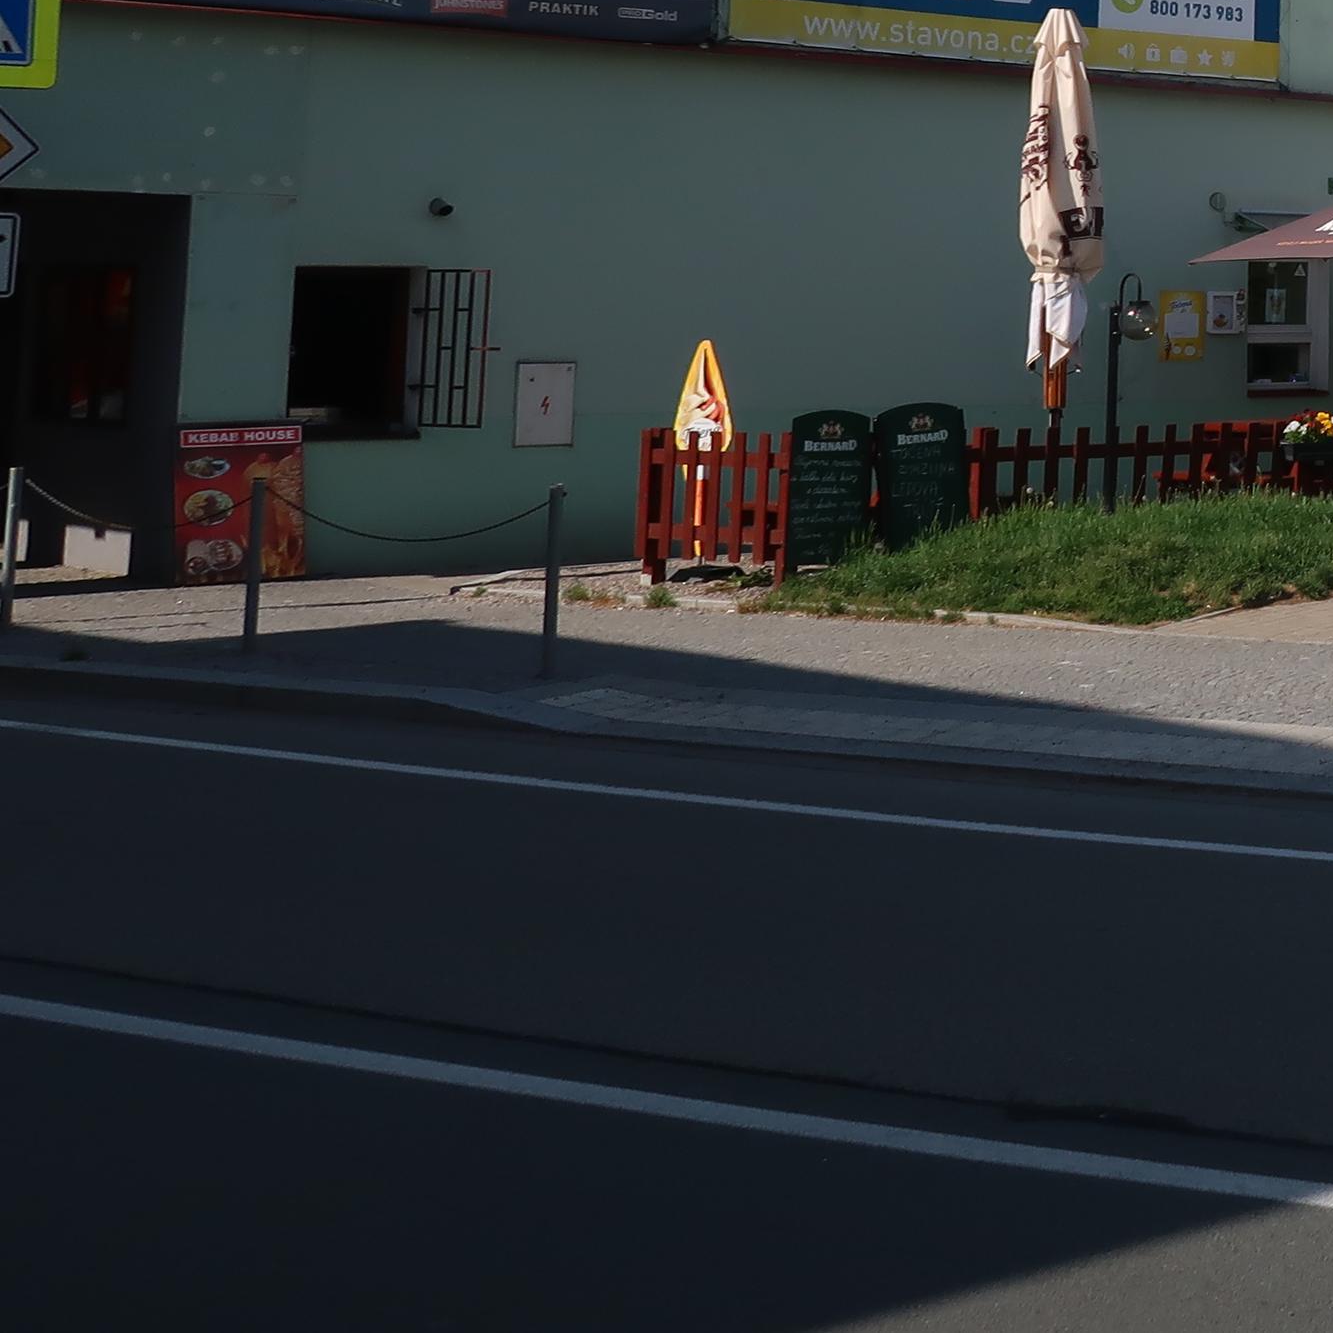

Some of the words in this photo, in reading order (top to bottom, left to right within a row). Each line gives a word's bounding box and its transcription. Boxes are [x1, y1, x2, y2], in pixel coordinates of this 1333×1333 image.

[528, 0, 600, 17] PRAKTIK
[1149, 0, 1179, 17] 800
[1183, 3, 1212, 19] 173
[1216, 6, 1244, 22] 983
[188, 431, 240, 445] KEBAB
[243, 430, 295, 442] HOUSE
[803, 439, 859, 453] BERNARD
[896, 429, 949, 446] BERNARD
